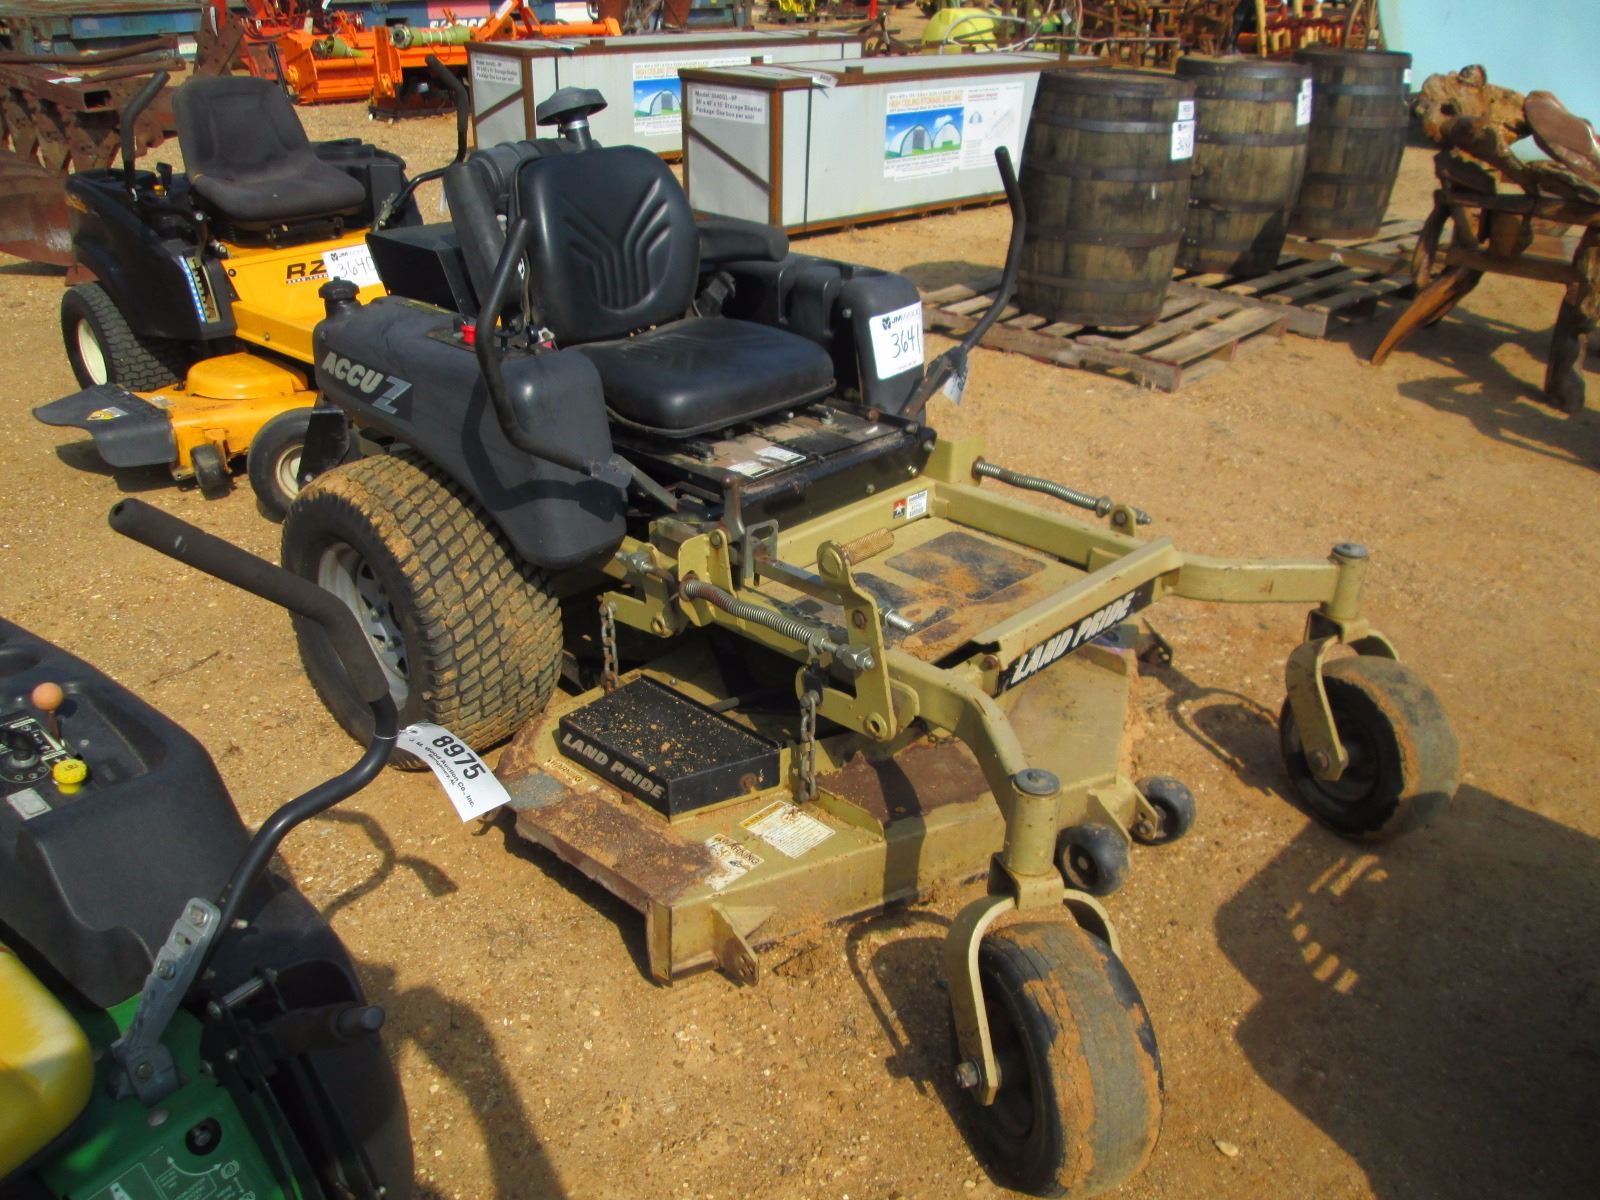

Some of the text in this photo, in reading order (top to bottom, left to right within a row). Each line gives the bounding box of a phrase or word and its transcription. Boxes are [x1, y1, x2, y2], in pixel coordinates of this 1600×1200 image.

[891, 324, 920, 359] 3641
[322, 351, 384, 394] ACCU
[1011, 591, 1136, 685] LAND PRIDE
[432, 735, 486, 780] 8975
[562, 733, 665, 799] LAND PRIDE
[441, 760, 459, 782] Auction
[466, 794, 475, 808] Inc.
